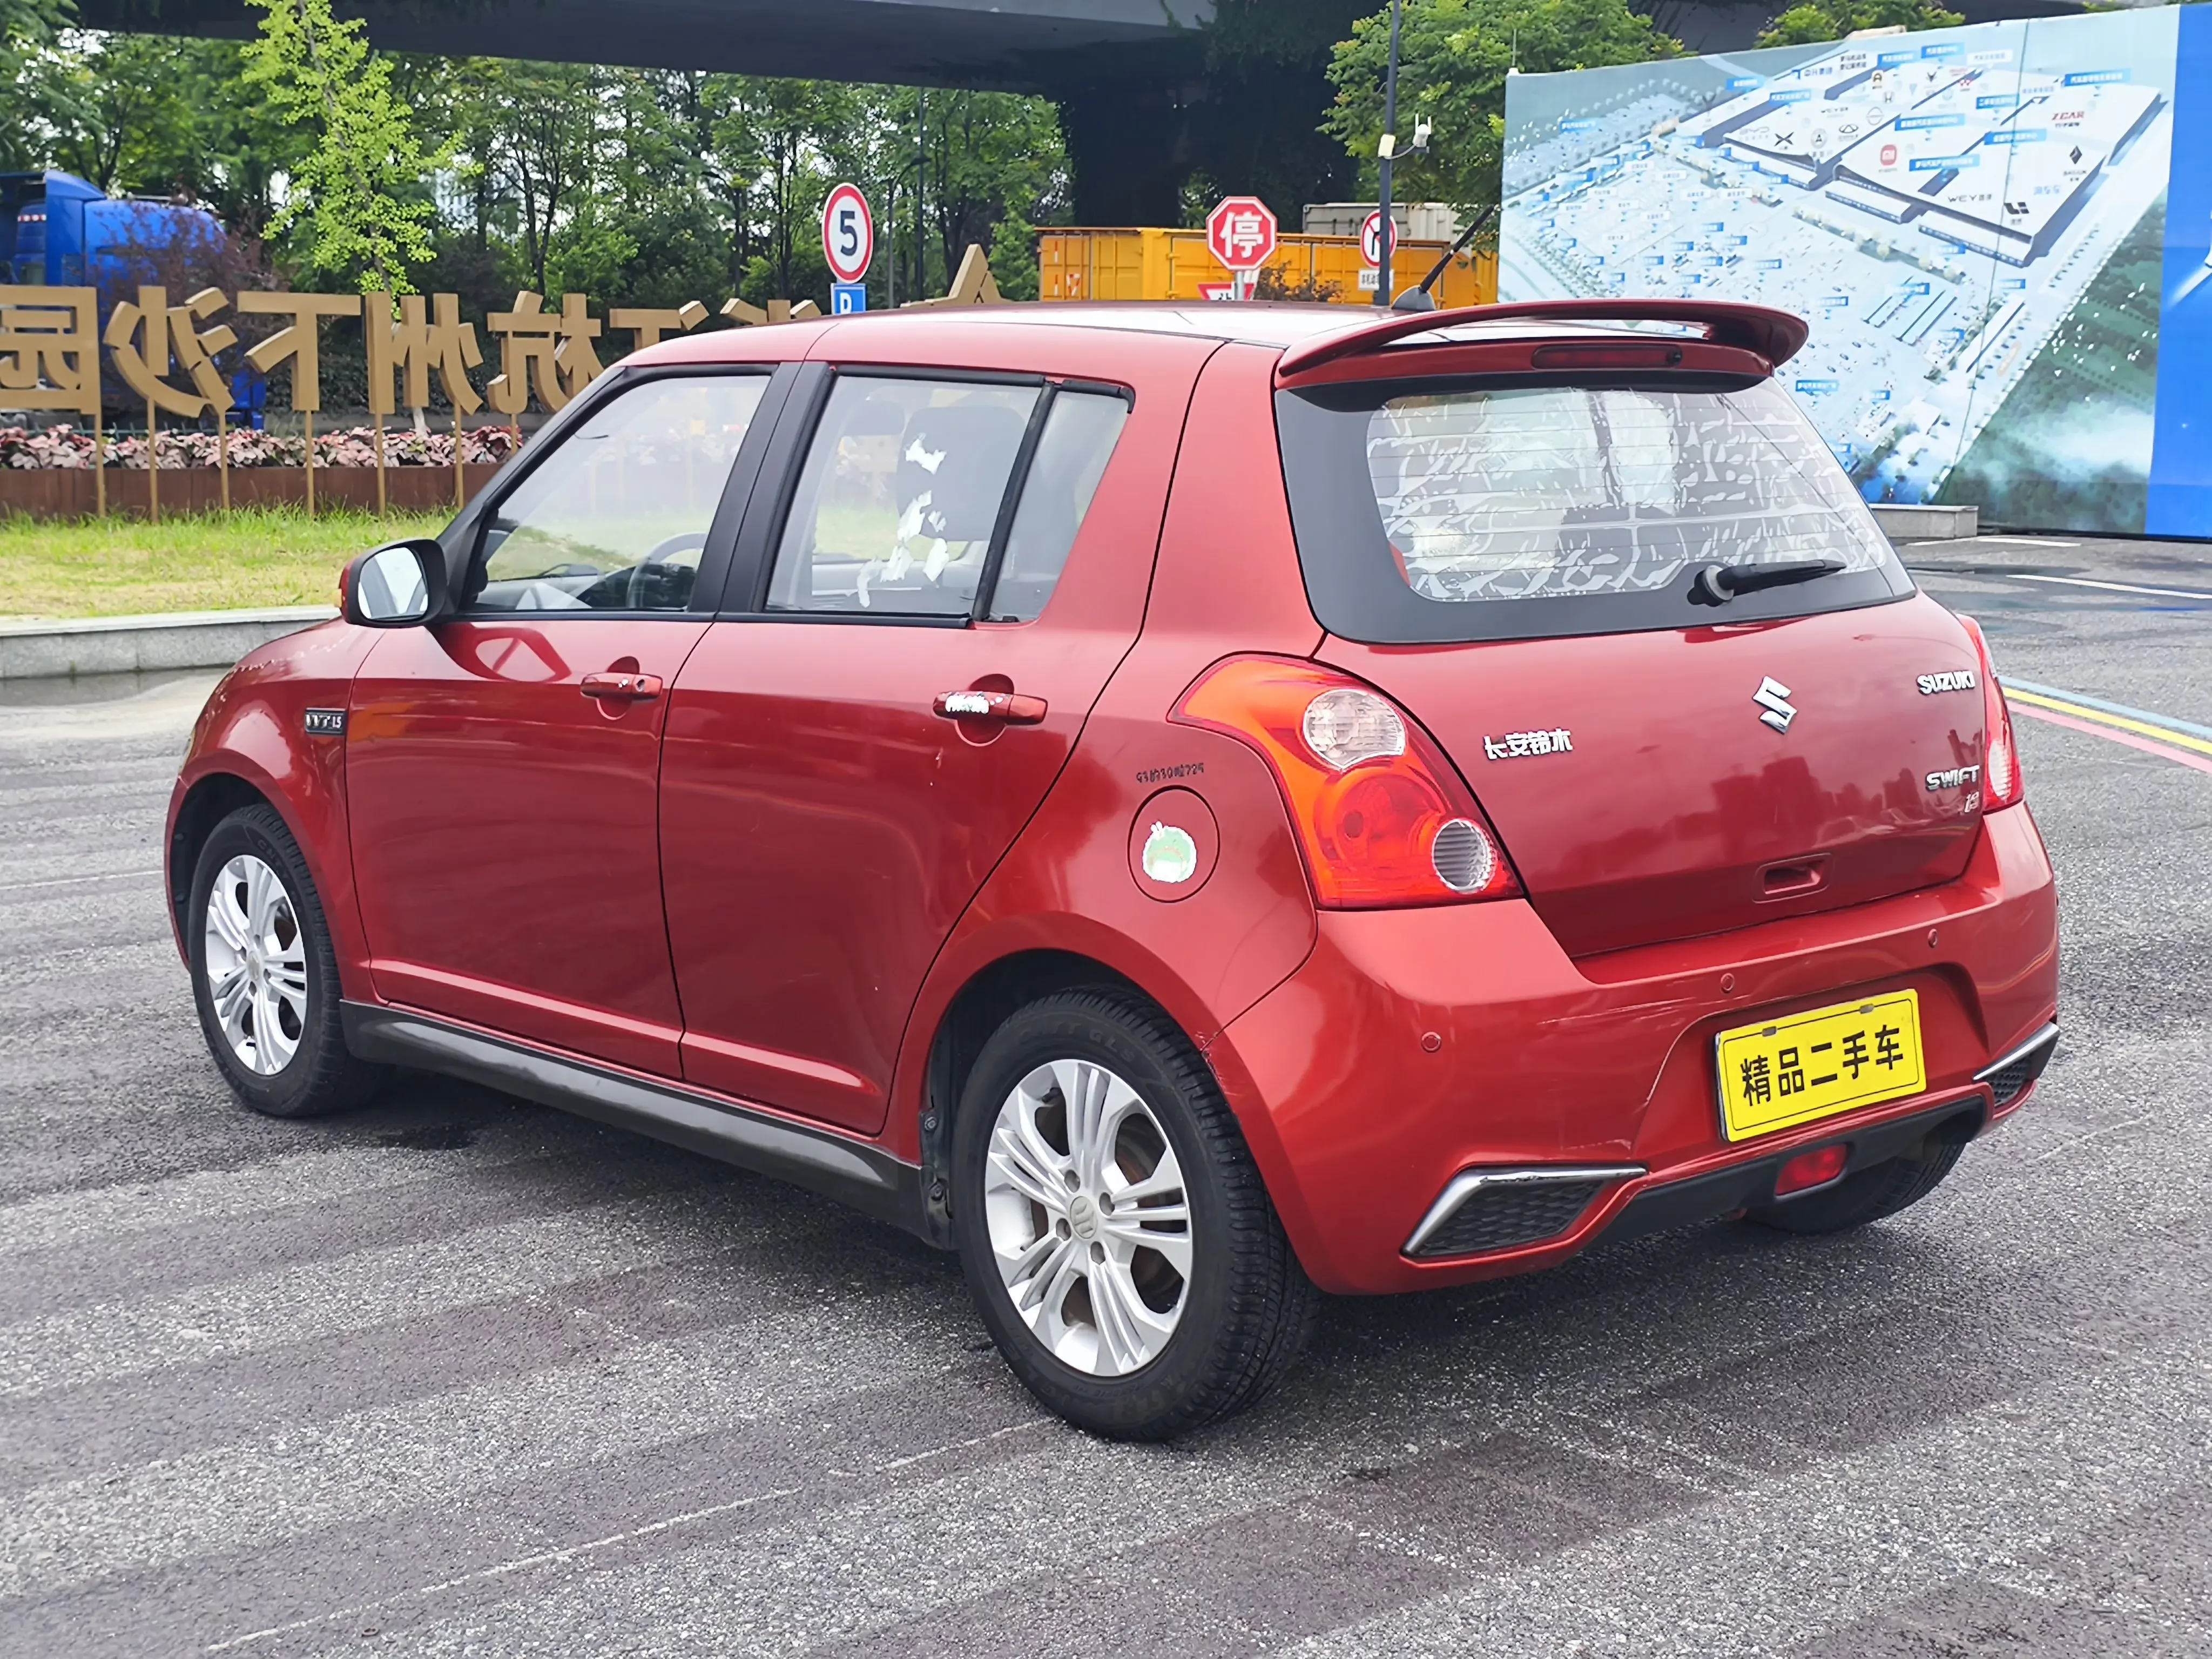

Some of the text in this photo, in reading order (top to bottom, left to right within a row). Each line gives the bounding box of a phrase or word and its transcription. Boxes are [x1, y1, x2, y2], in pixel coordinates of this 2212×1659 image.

[840, 210, 858, 257] 5
[1219, 210, 1264, 258] 停
[1917, 671, 1976, 694] SUZUKI
[1483, 727, 1574, 760] 长安铃木
[1926, 765, 1980, 791] SWIFT
[1740, 1024, 1904, 1107] 精品二手车
